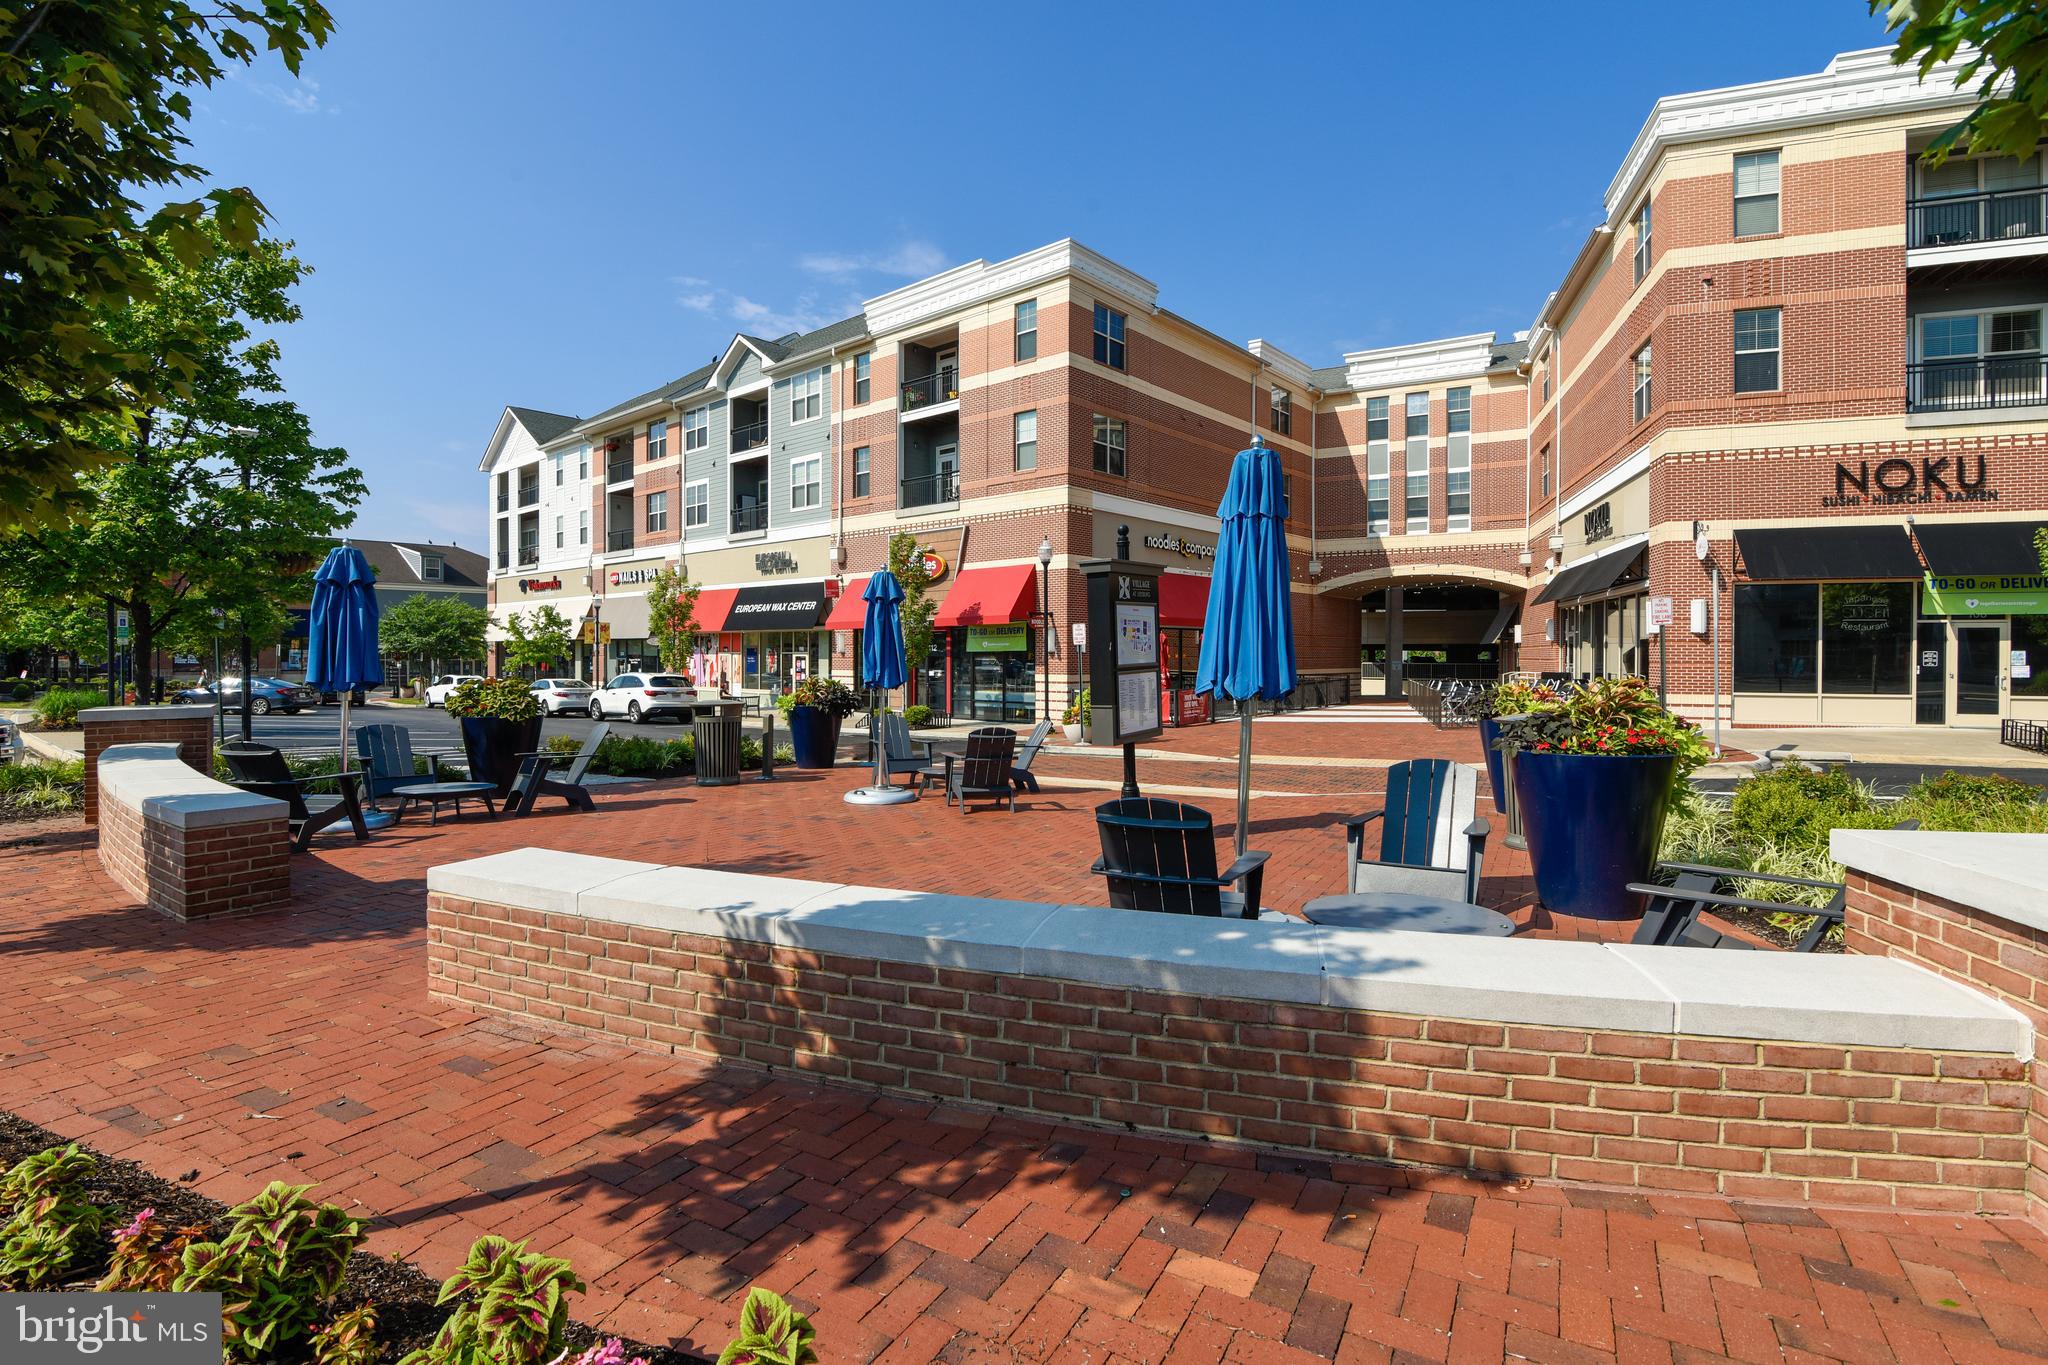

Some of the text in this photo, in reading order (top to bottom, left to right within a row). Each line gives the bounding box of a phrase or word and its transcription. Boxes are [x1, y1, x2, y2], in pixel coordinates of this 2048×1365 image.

[1836, 455, 1986, 496] NOKU
[1822, 489, 1999, 507] SUSHI HIBACHI RAMEN
[1147, 535, 1179, 551] noodles
[1185, 543, 1216, 559] compan
[619, 570, 637, 582] NAILS
[1930, 578, 1976, 590] TO-GO
[1980, 581, 1996, 589] OR
[735, 601, 817, 613] EUROPEAN WAX CENTER
[996, 627, 1025, 635] DELIVERY
[1841, 621, 1889, 631] Restaurant
